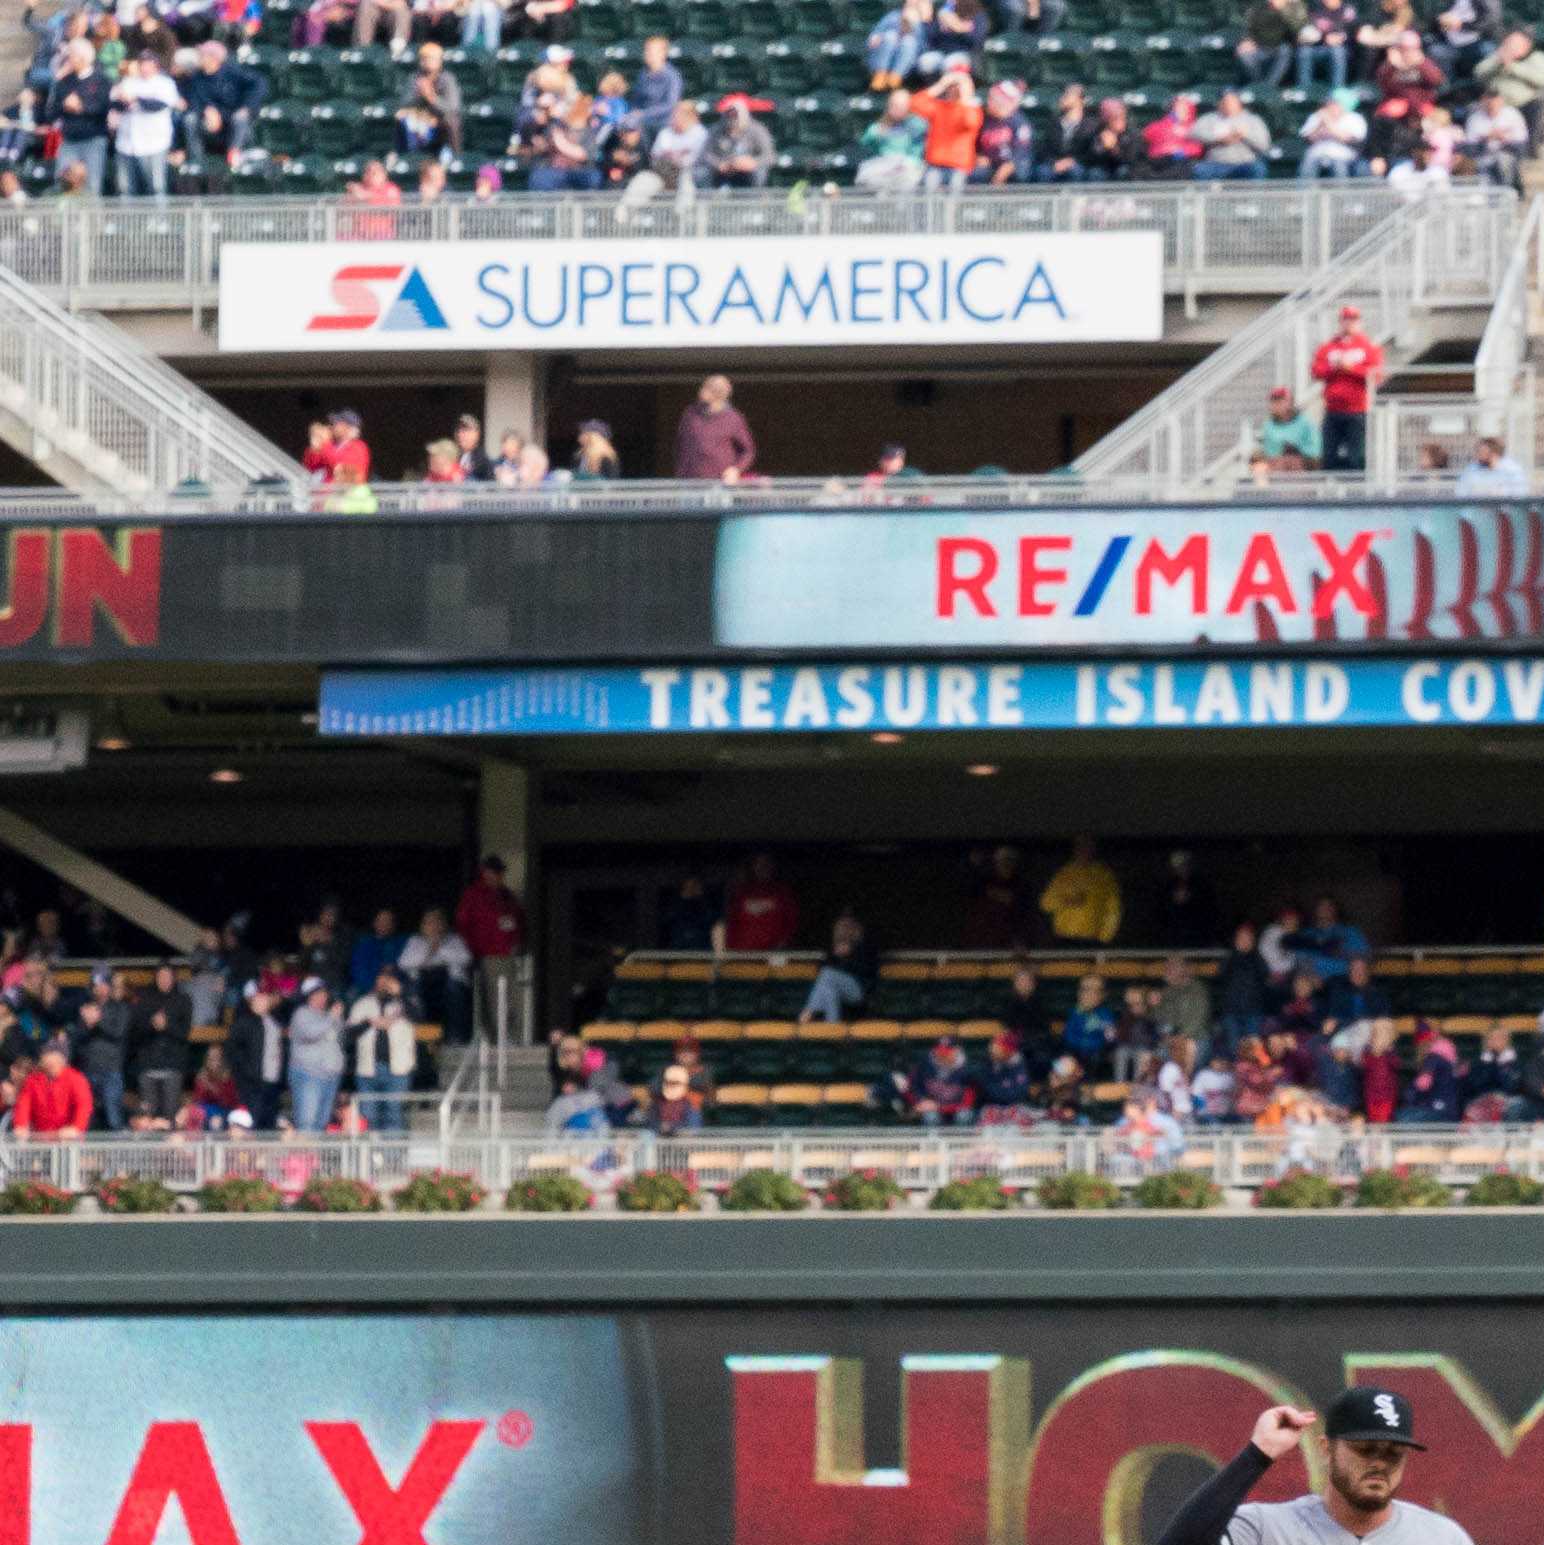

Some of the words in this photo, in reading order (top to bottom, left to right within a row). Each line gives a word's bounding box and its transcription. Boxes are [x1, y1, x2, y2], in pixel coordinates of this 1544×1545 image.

[475, 255, 1067, 329] SUPERAMERICA
[935, 529, 1381, 619] RE/MAX
[640, 664, 1024, 729] TREASURE
[1073, 662, 1350, 726] ISLAND
